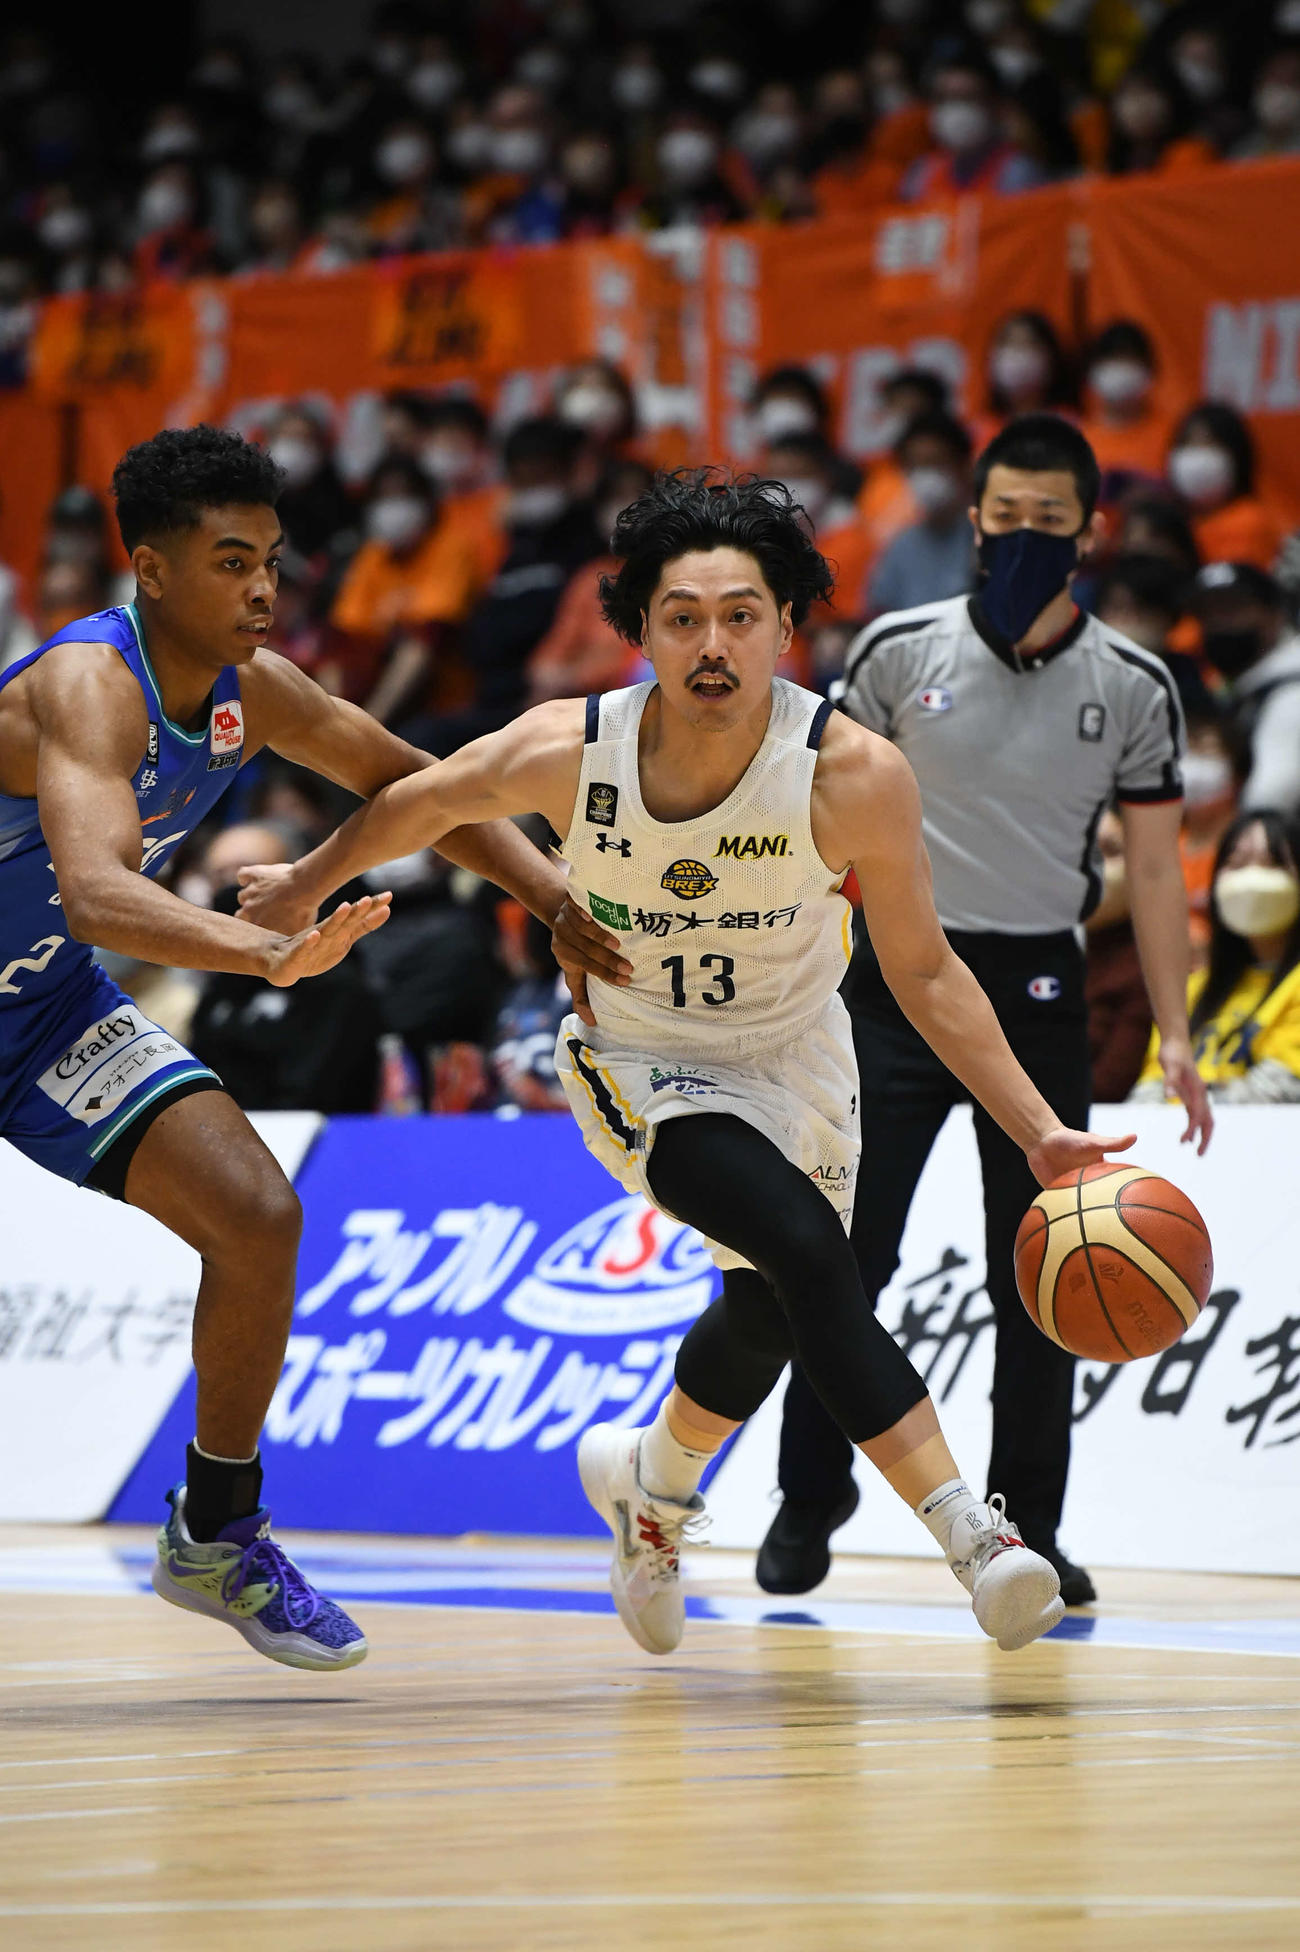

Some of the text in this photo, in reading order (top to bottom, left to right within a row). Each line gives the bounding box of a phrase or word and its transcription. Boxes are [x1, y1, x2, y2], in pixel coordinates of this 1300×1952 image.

[712, 834, 788, 860] MANI
[662, 878, 717, 891] BREX
[632, 902, 803, 938] 栃木銀行
[661, 953, 736, 1009] 13
[56, 1014, 136, 1080] Crafty
[297, 1203, 538, 1317] アップル
